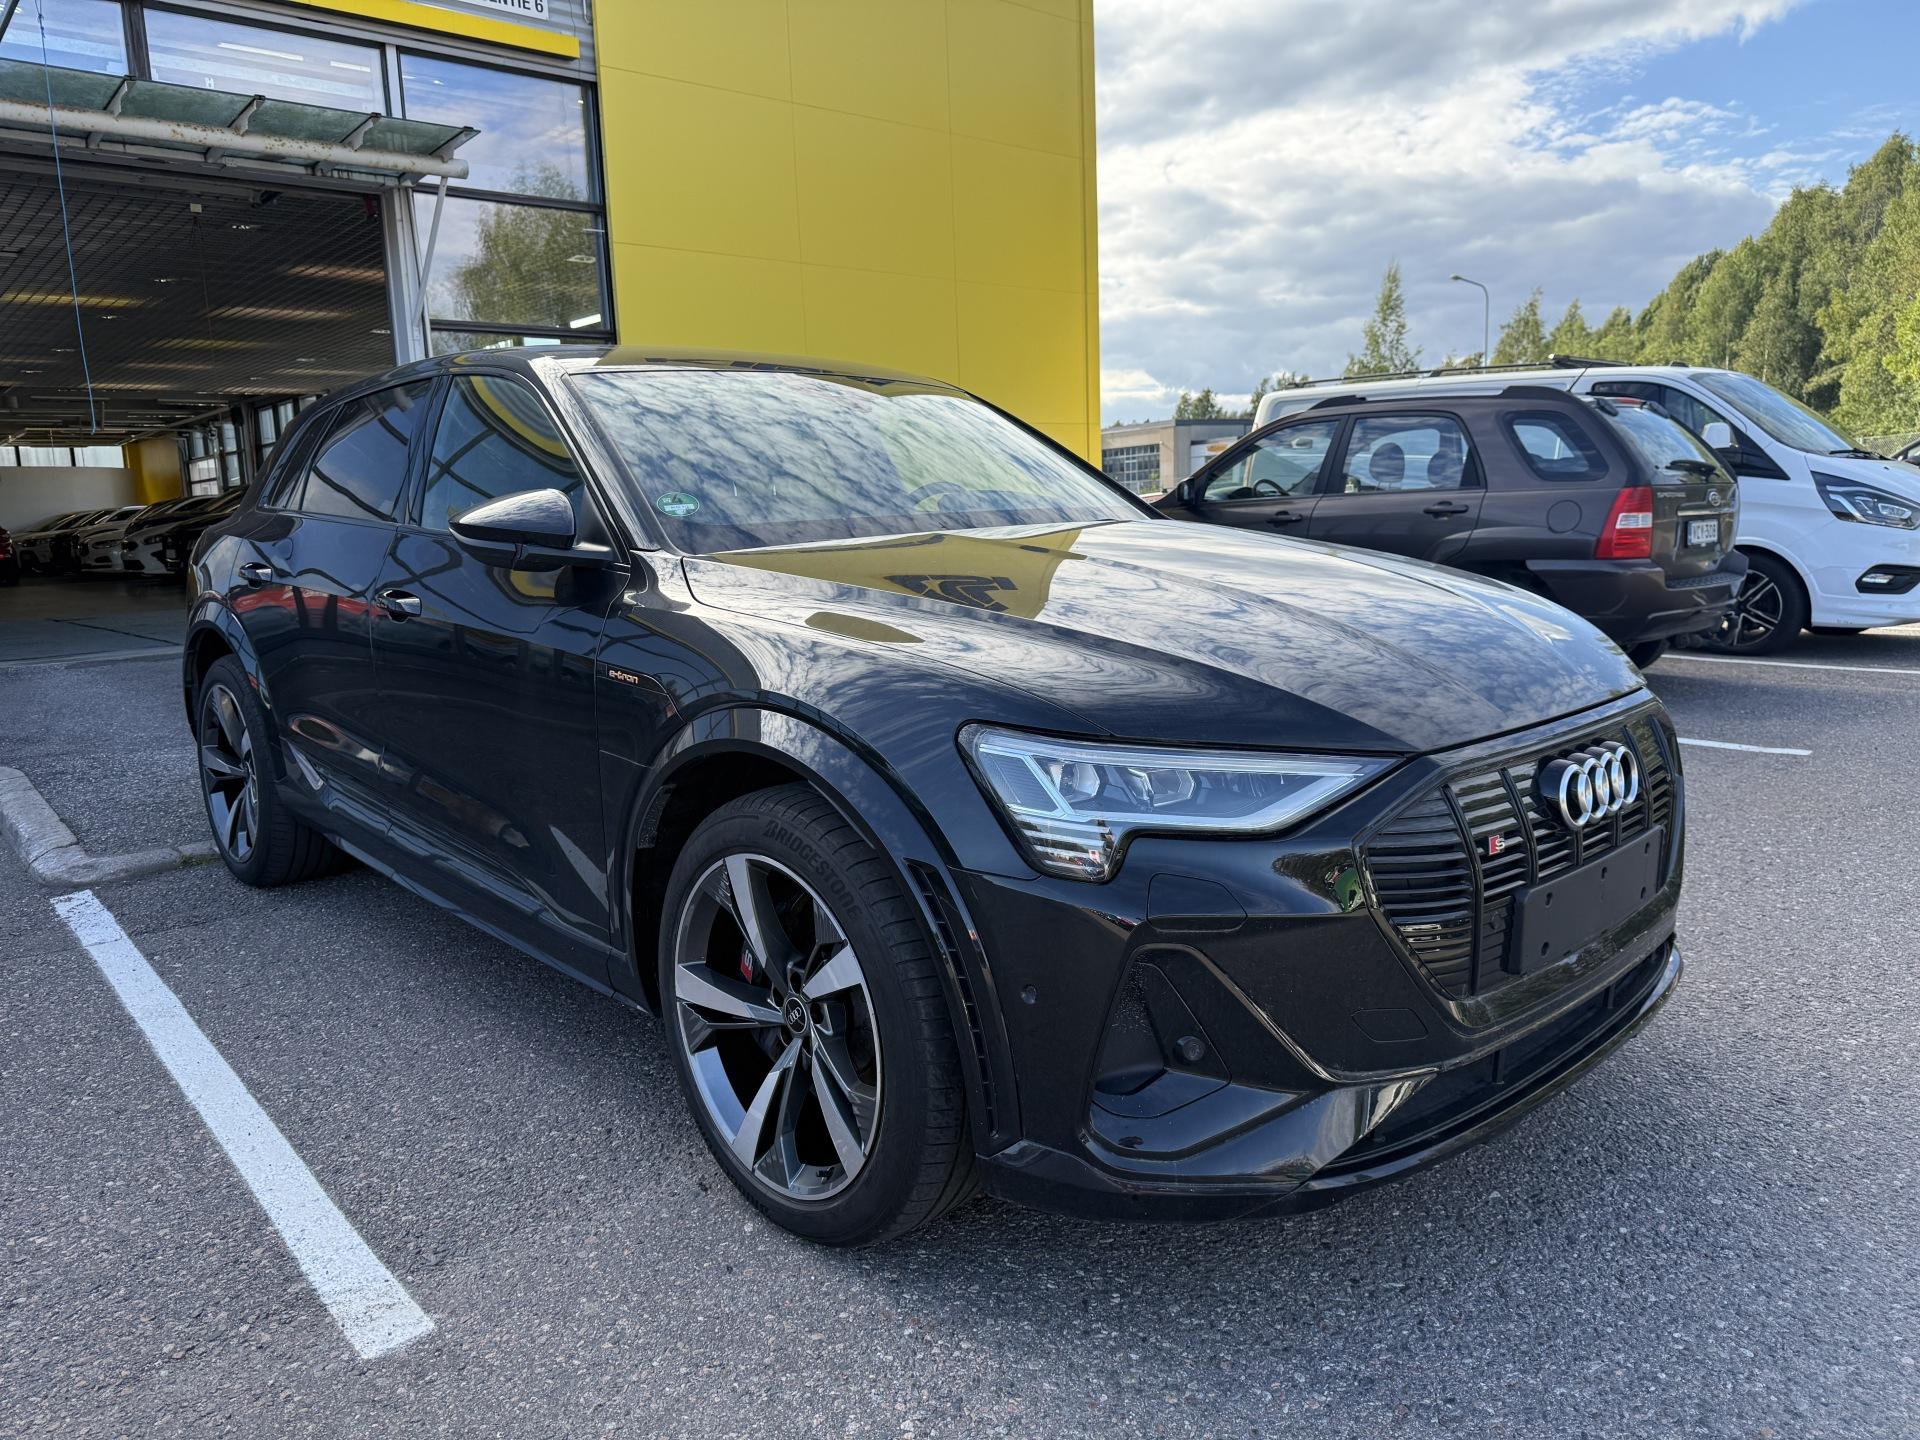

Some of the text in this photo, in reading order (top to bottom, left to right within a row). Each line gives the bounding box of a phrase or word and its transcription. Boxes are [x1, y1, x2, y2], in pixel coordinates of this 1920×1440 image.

[535, 0, 544, 13] 6
[608, 669, 639, 684] e-tron
[763, 819, 864, 918] BRIDGESTONE
